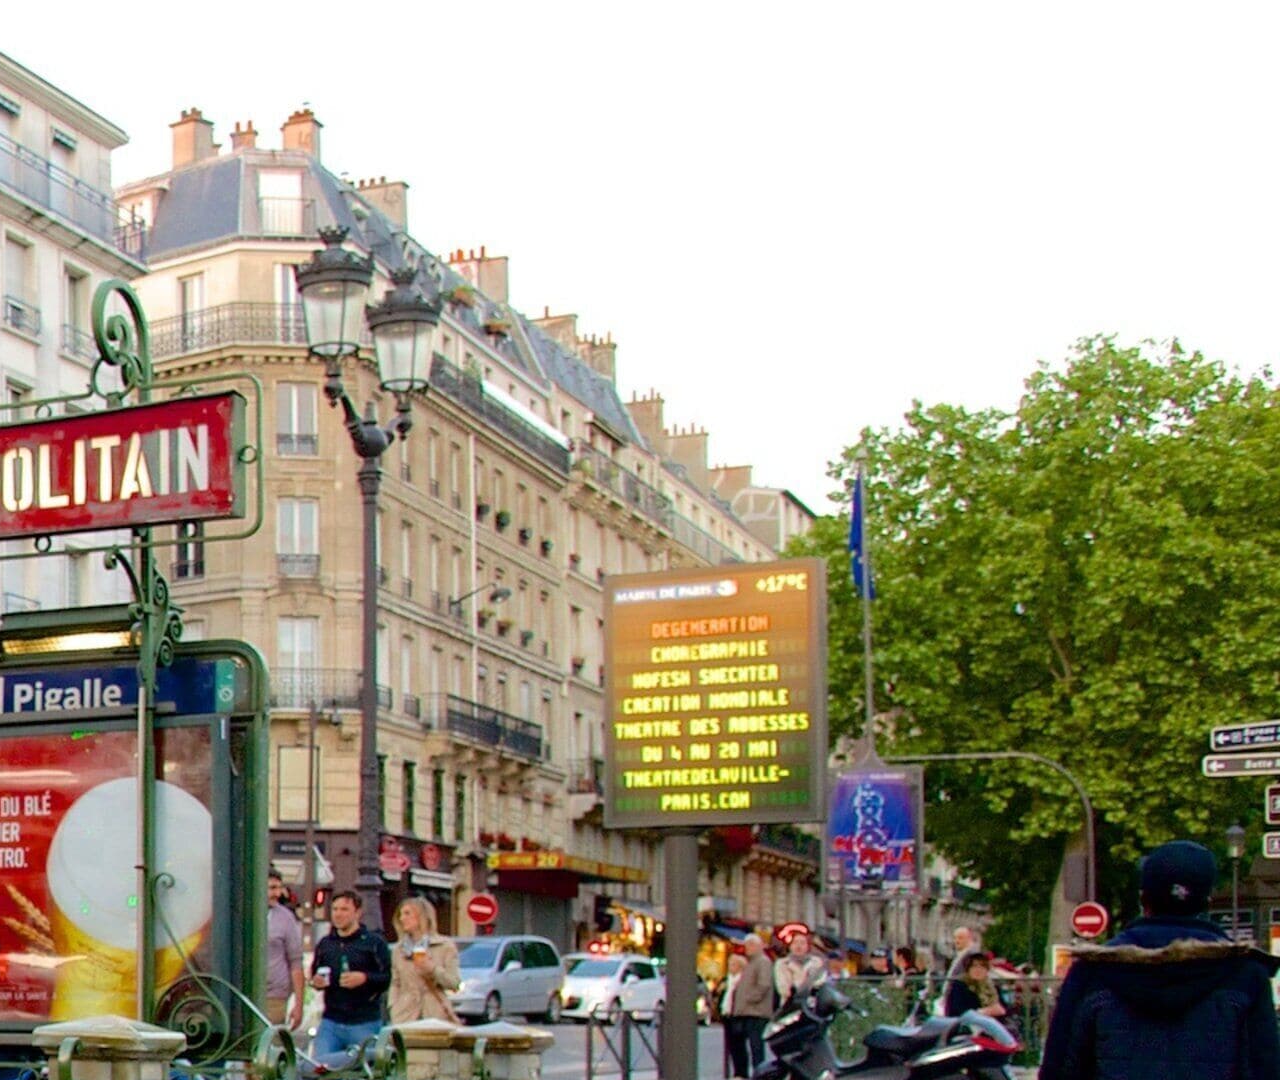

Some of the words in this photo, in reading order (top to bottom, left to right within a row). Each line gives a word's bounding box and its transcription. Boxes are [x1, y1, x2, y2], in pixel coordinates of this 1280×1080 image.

[651, 615, 769, 638] DEGENERATION
[650, 640, 769, 664] CHOREGRAPHIE
[632, 670, 691, 689] HOFESH
[698, 664, 779, 685] SHECHTER
[13, 678, 122, 713] Pigalle
[623, 693, 701, 714] CREATION
[708, 688, 789, 710] MONDIALE
[614, 719, 682, 739] THEATRE
[689, 717, 721, 736] DES
[728, 713, 809, 733] ABBESSES
[641, 745, 664, 763] DU
[670, 745, 682, 761] 4
[689, 743, 711, 761] AU
[718, 741, 740, 759] 20
[747, 739, 778, 758] MAI
[623, 764, 791, 788] THEATREDELAVILLE-
[0, 797, 18, 816] DU
[24, 790, 53, 816] BLÉ
[660, 791, 751, 812] PARIS.COM
